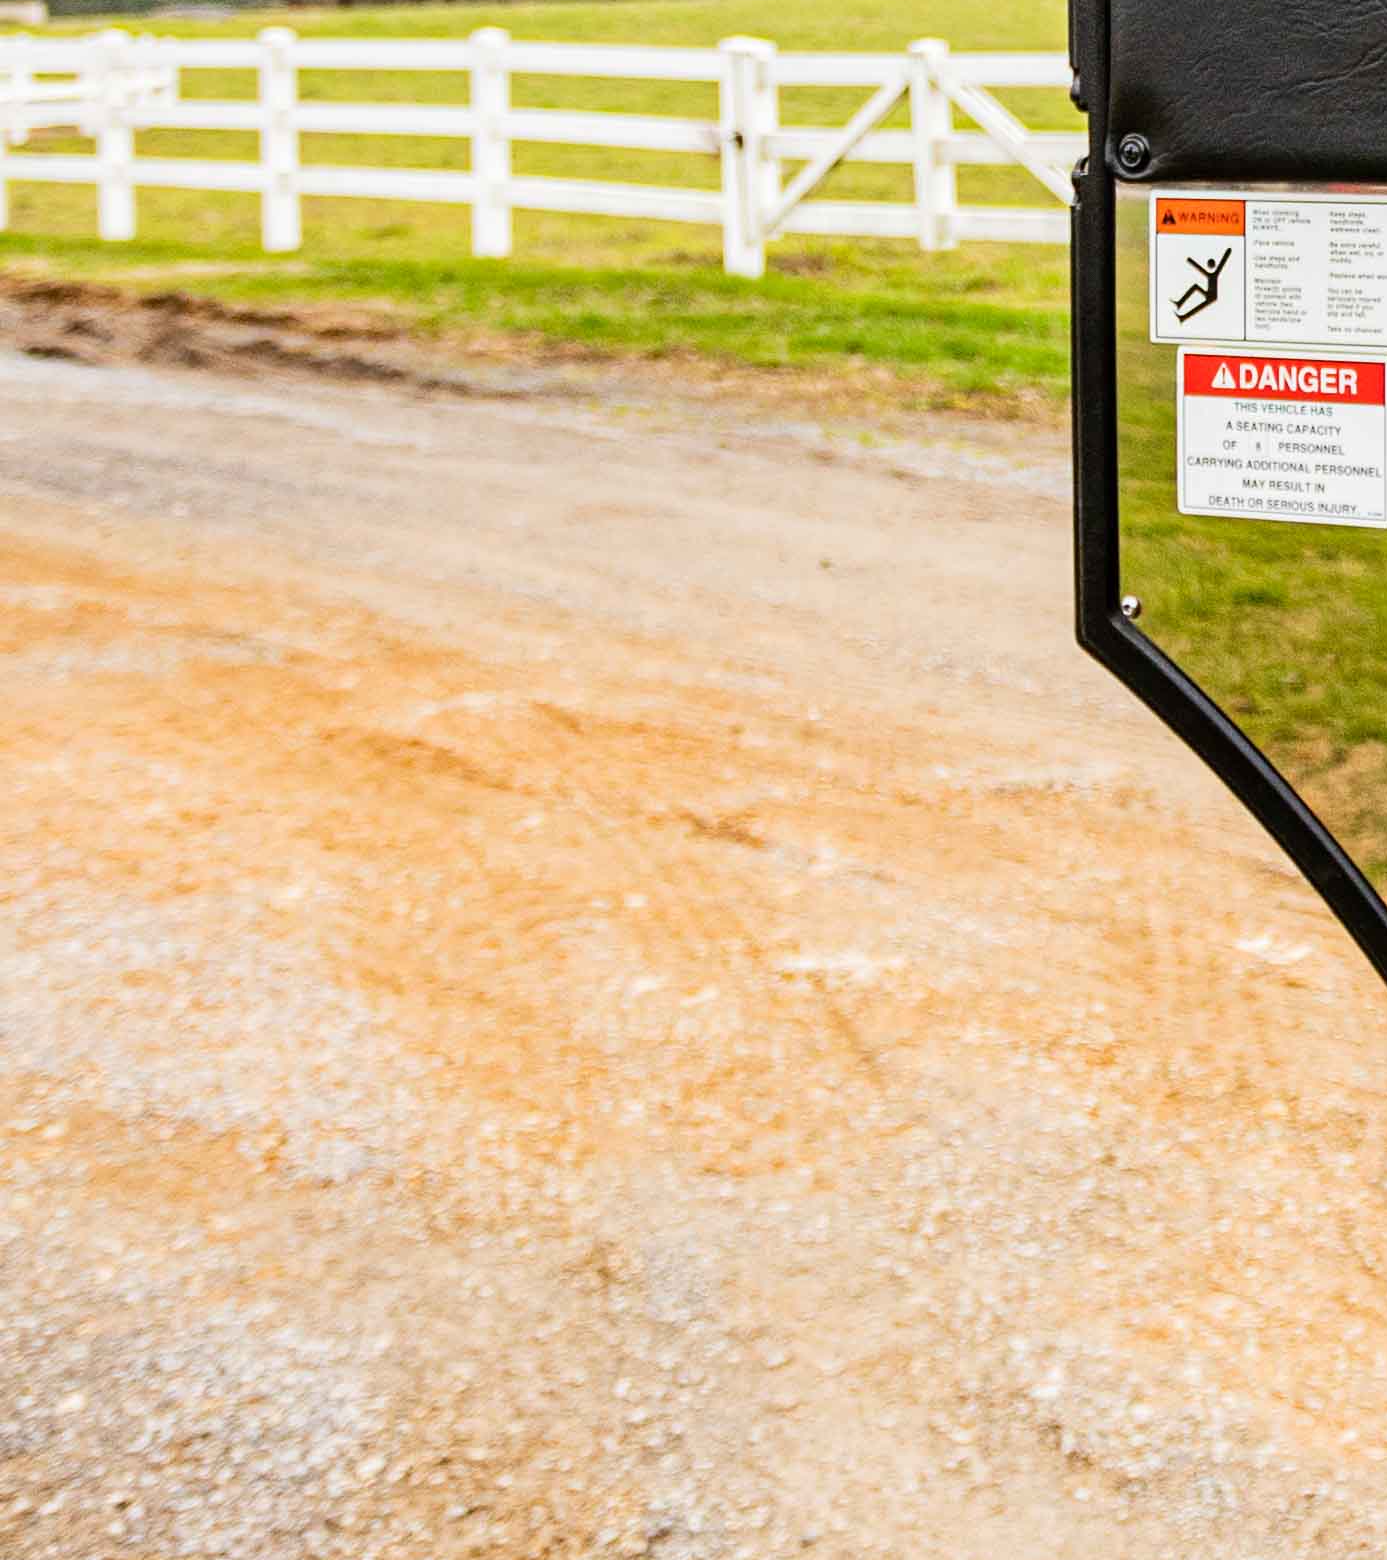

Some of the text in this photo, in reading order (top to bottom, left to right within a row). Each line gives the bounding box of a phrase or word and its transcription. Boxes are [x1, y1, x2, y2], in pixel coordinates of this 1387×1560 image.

[1177, 211, 1240, 225] WARNING
[1239, 363, 1358, 395] DANGER
[1234, 401, 1334, 416] THIS VEHICLE HAS
[1225, 420, 1341, 436] A SEATING CAPACITY
[1222, 440, 1237, 450] OF
[1278, 441, 1345, 456] PERSONNEL
[1187, 455, 1382, 478] CARRYING ADDITIONAL PERSONNEL
[1241, 479, 1326, 493] MAY RESULT IN
[1208, 495, 1244, 508] DEATH
[1248, 497, 1263, 509] OR
[1266, 499, 1315, 512] SERIOUS
